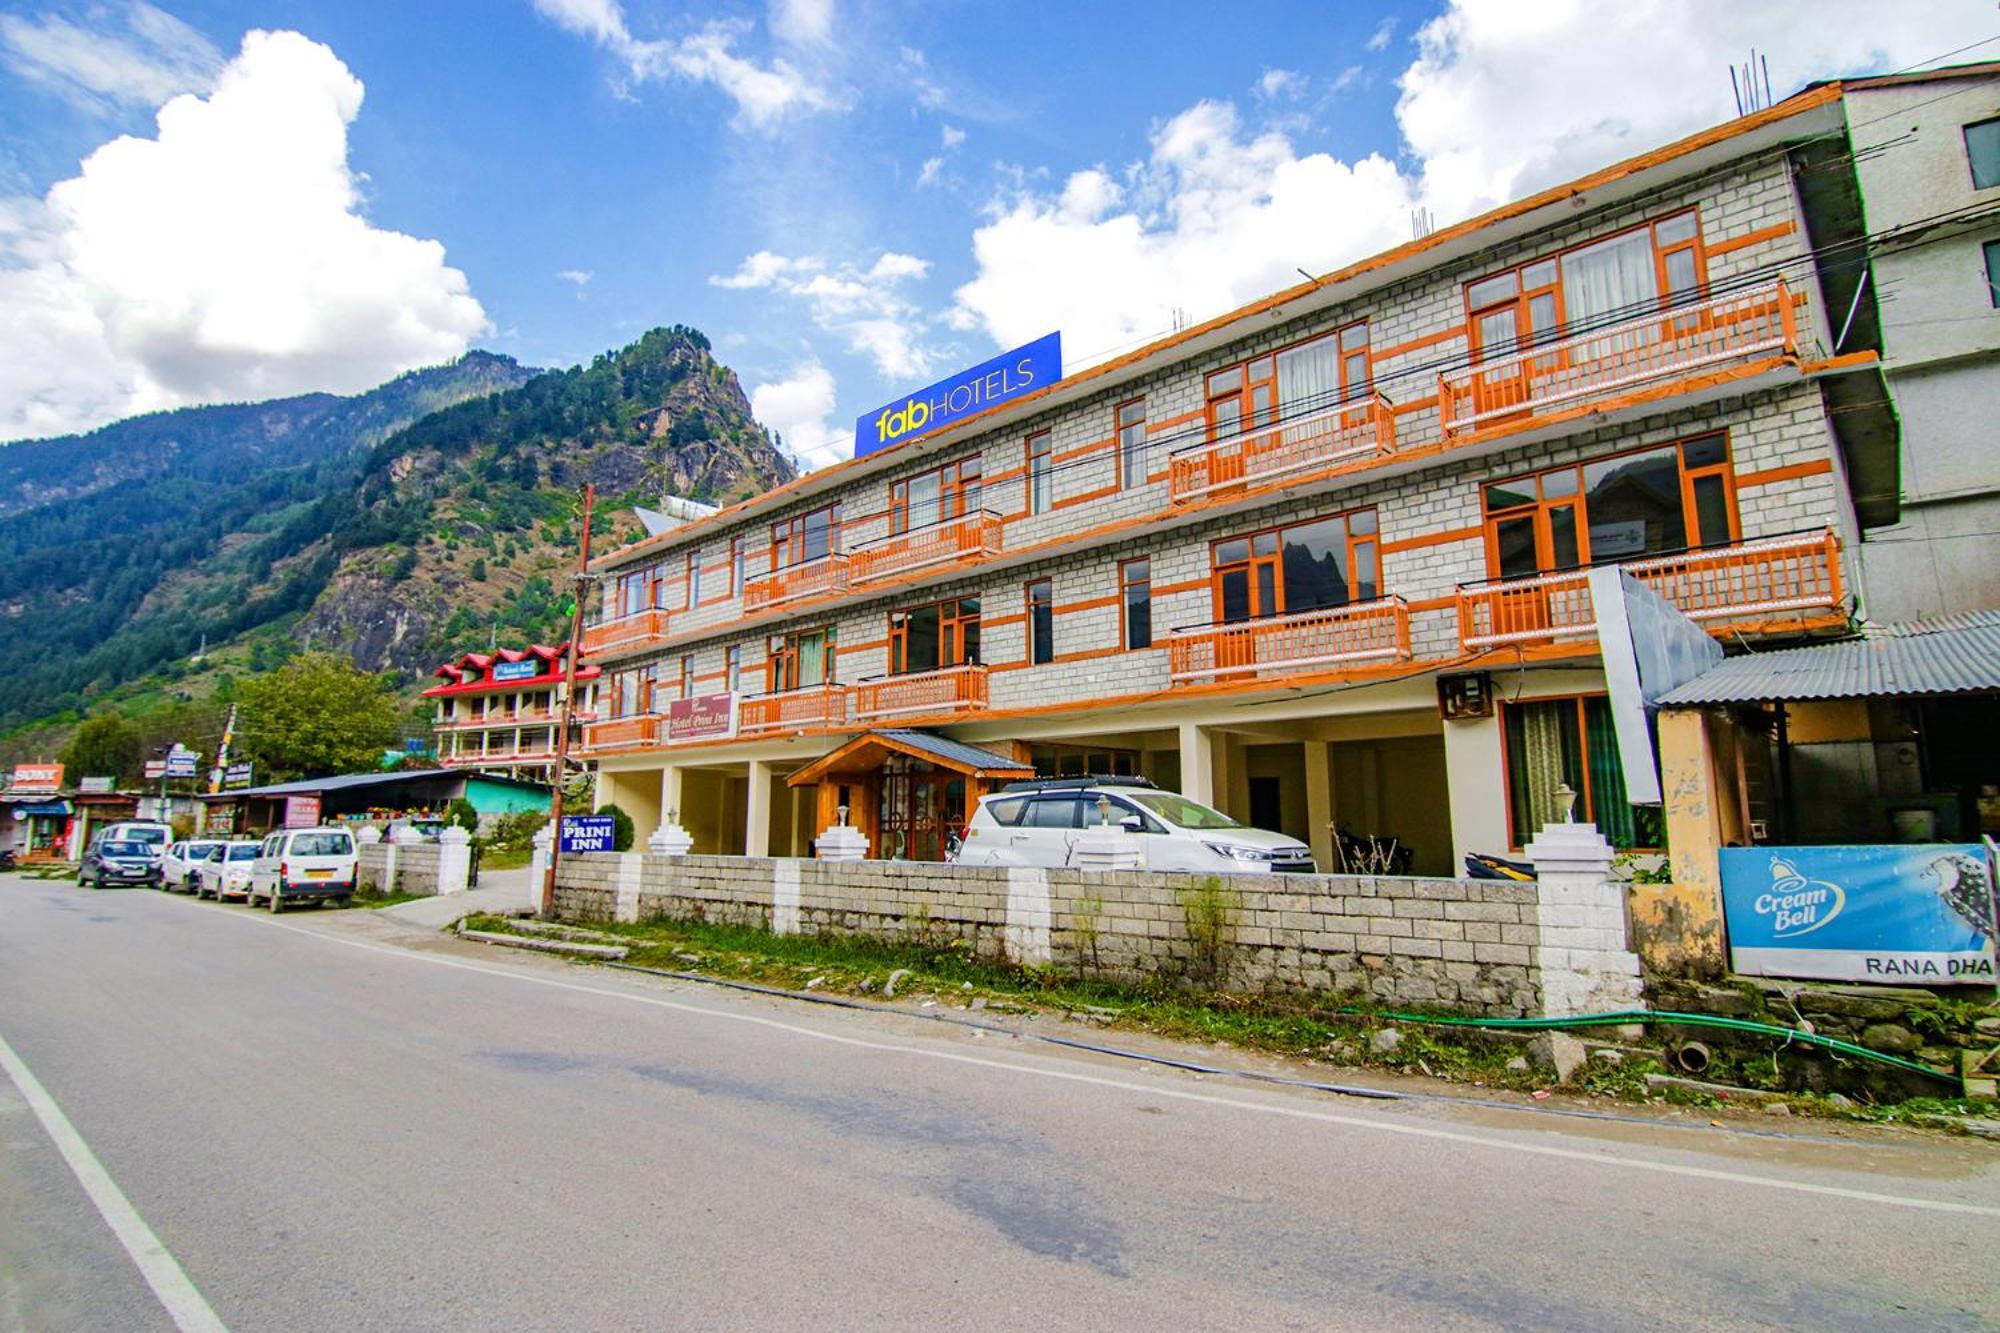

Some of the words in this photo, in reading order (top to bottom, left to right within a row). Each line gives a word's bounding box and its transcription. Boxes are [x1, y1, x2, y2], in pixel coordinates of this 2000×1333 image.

[876, 358, 1034, 443] fabHOTELS
[714, 711, 729, 725] Inn
[564, 826, 611, 838] PRINI
[571, 838, 602, 850] INN
[1755, 889, 1827, 914] Cream
[1775, 905, 1816, 930] Bell
[1866, 958, 1939, 976] RANA
